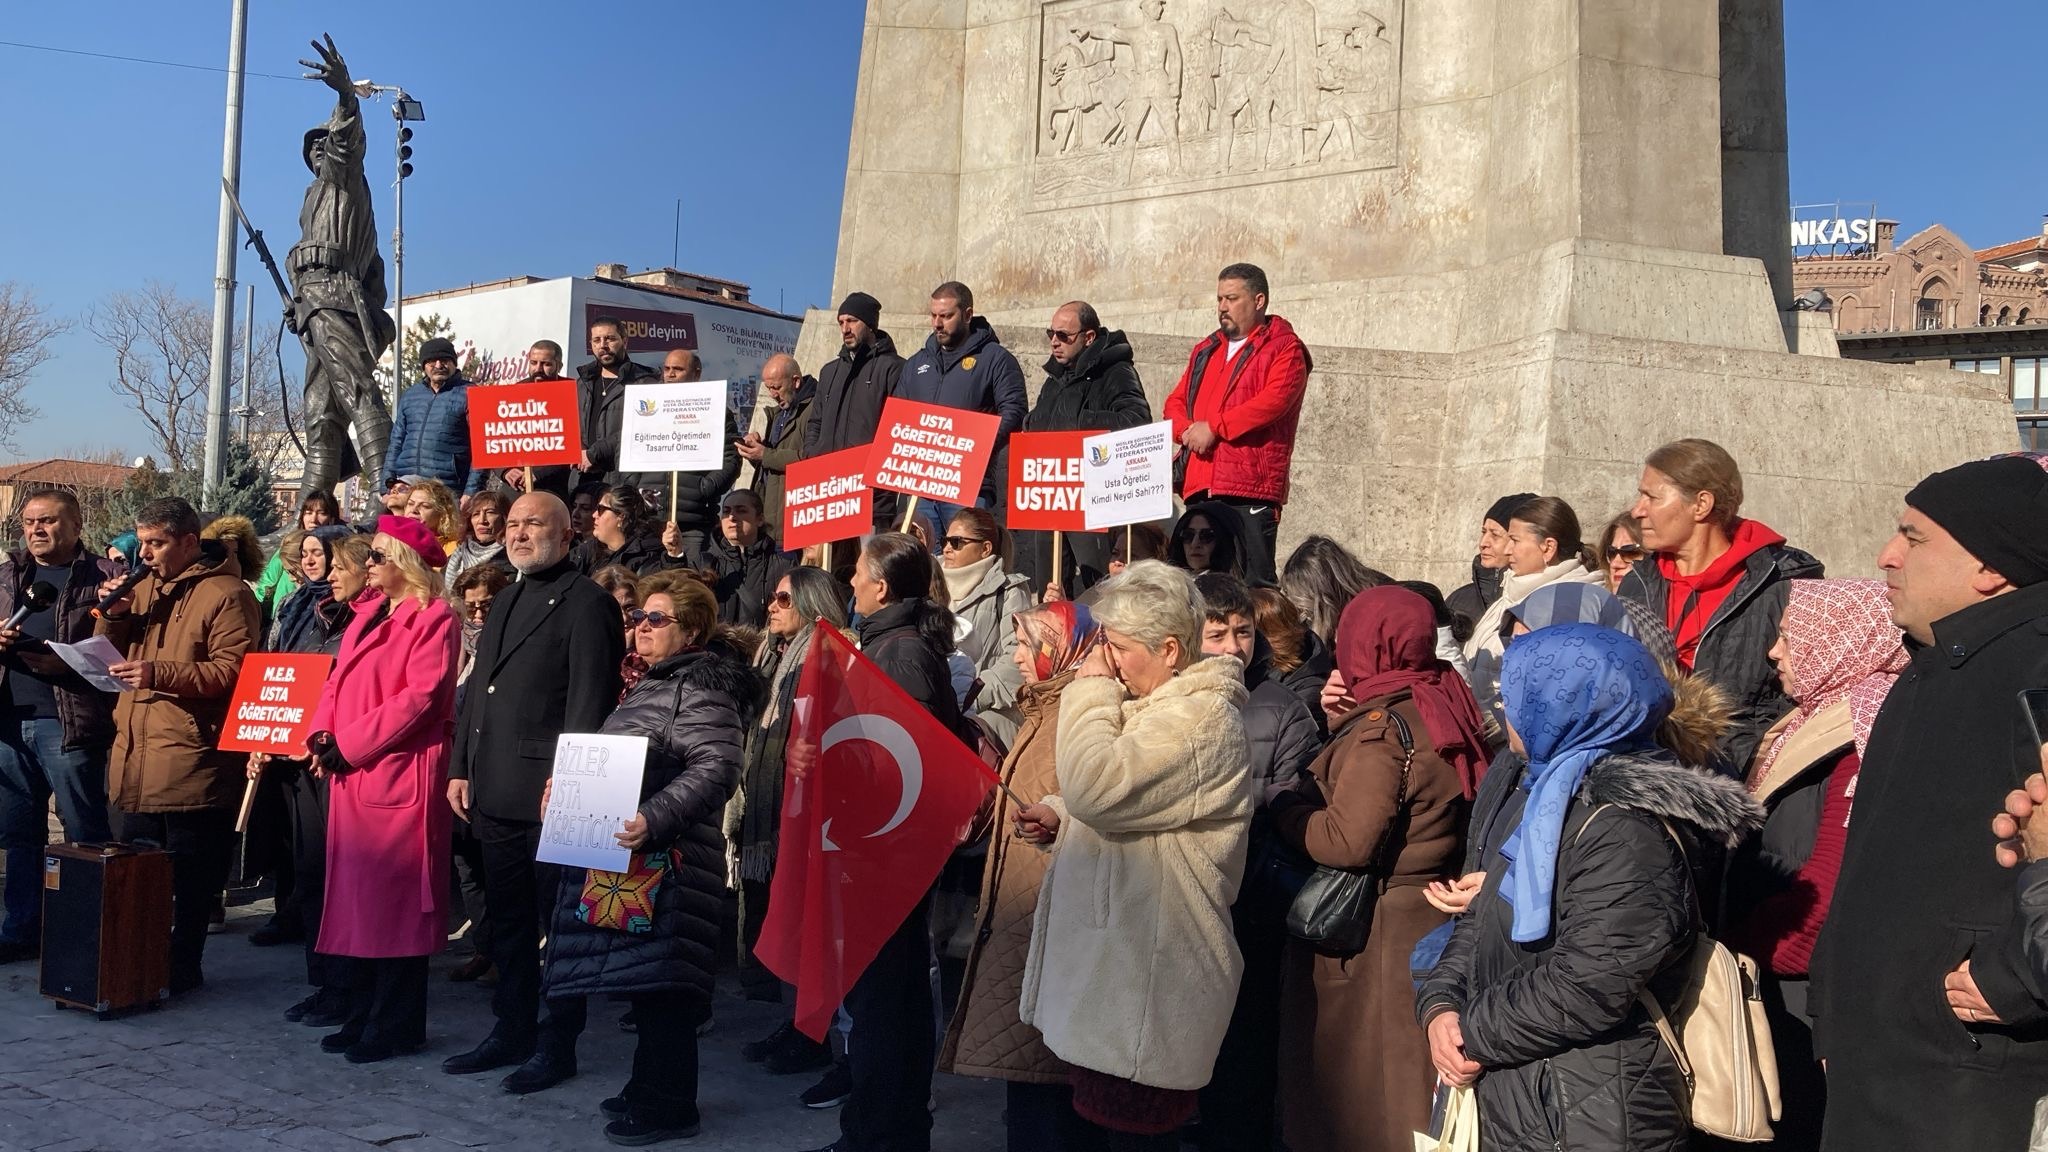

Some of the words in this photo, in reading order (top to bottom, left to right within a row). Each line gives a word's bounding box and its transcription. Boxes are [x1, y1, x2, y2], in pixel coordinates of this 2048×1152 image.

[1791, 219, 1876, 246] NKASI
[711, 323, 738, 335] SOSYAL
[740, 328, 773, 340] BİLİMLER
[726, 335, 773, 351] TÜRKİYE'NİN
[497, 399, 548, 419] ÖZLÜK
[485, 418, 564, 436] HAKKIMIZI
[919, 413, 953, 431] USTA
[486, 436, 565, 454] İSTİYORUZ
[634, 432, 669, 442] Eğitimden
[671, 431, 710, 442] Öğretimden
[890, 422, 975, 453] ÖĞRETİCİLER
[646, 444, 674, 452] Tasarruf
[891, 442, 963, 468] DEPREMDE
[1115, 444, 1164, 459] FEDERASYONU
[882, 457, 961, 484] ALANLARDA
[876, 471, 960, 499] OLANLARDIR
[1104, 479, 1121, 489] Usta
[1122, 472, 1150, 487] Öğretici
[785, 473, 868, 507] MESLEĞİMİZ
[1091, 493, 1113, 504] Kimdi
[1114, 490, 1134, 502] Neydi
[1135, 484, 1165, 498] Sahi???
[792, 505, 824, 528] İADE
[827, 497, 861, 521] EDİN
[263, 667, 296, 682] M.E.B.
[260, 686, 289, 702] USTA
[237, 702, 304, 723] ÖĞRETİCİNE
[236, 725, 271, 741] SAHİP
[270, 727, 292, 744] ÇIK
